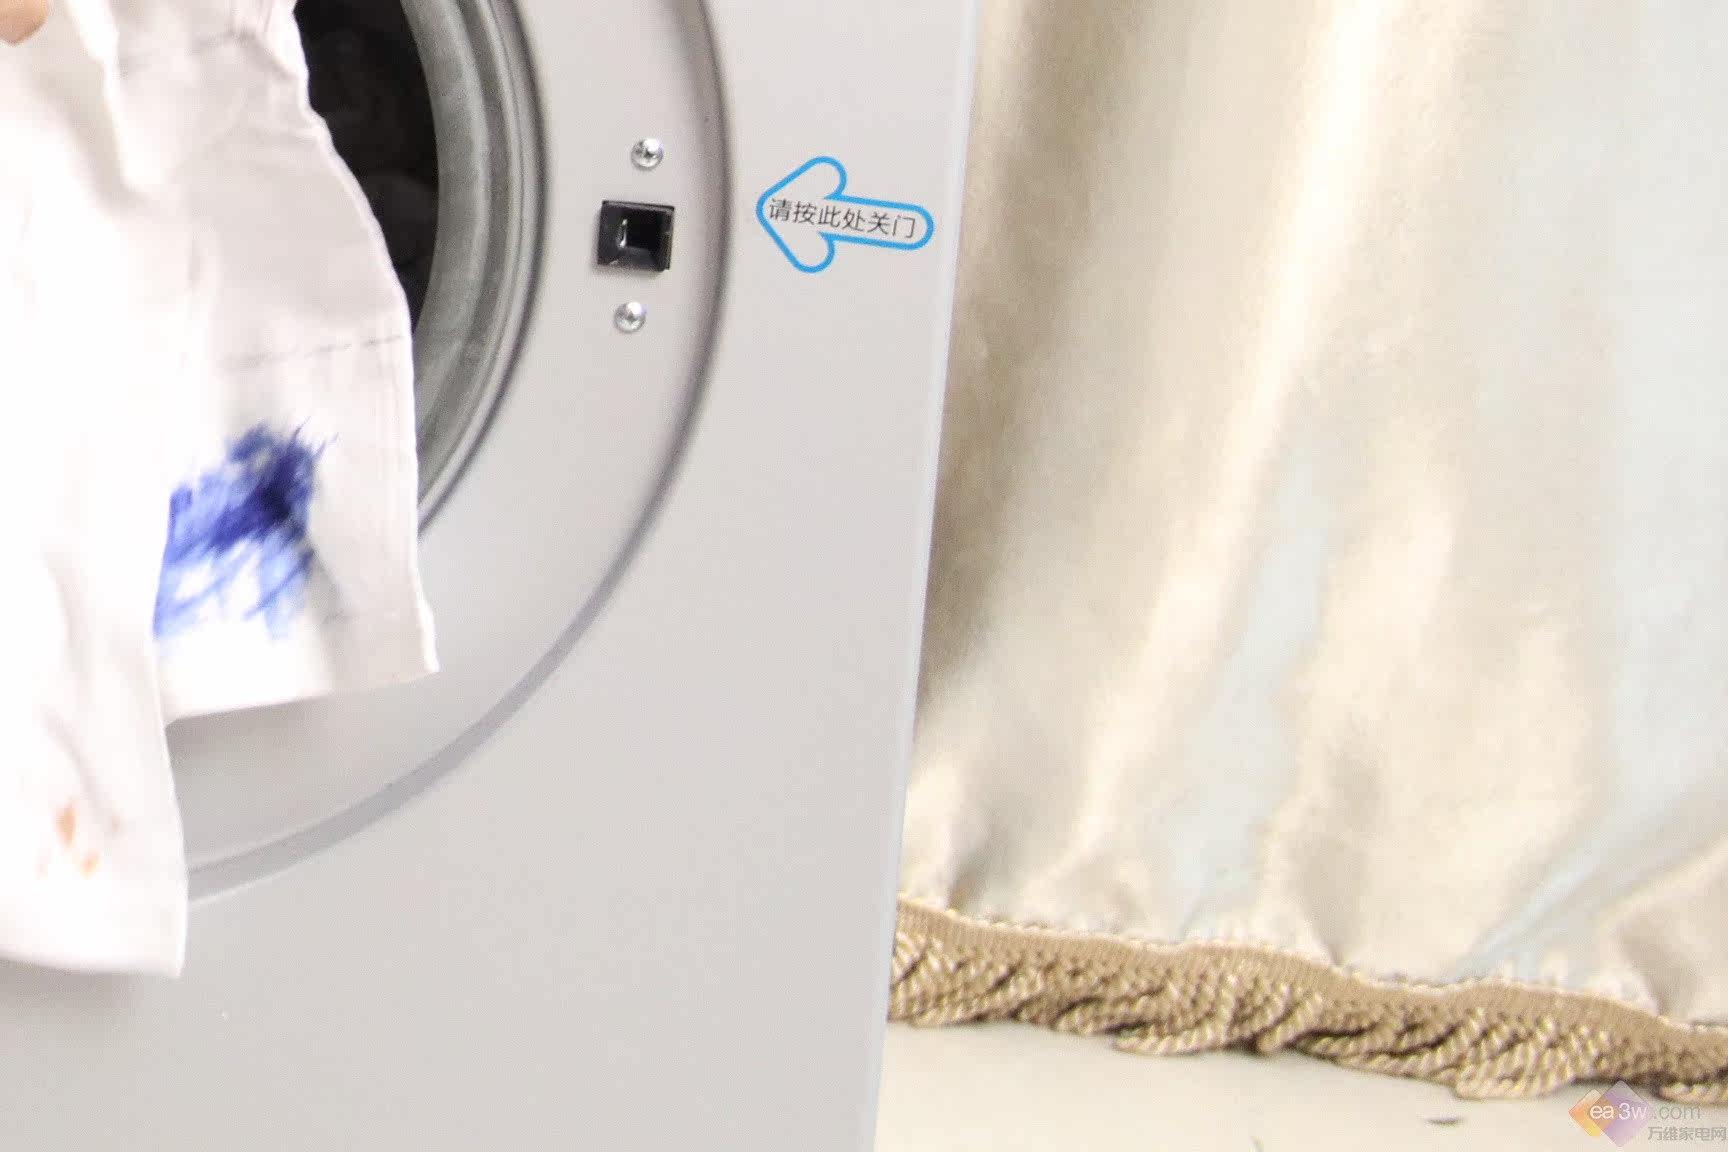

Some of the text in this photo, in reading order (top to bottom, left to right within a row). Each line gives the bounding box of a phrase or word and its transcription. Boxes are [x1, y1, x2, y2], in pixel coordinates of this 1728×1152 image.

[769, 198, 917, 239] 请按此处关门
